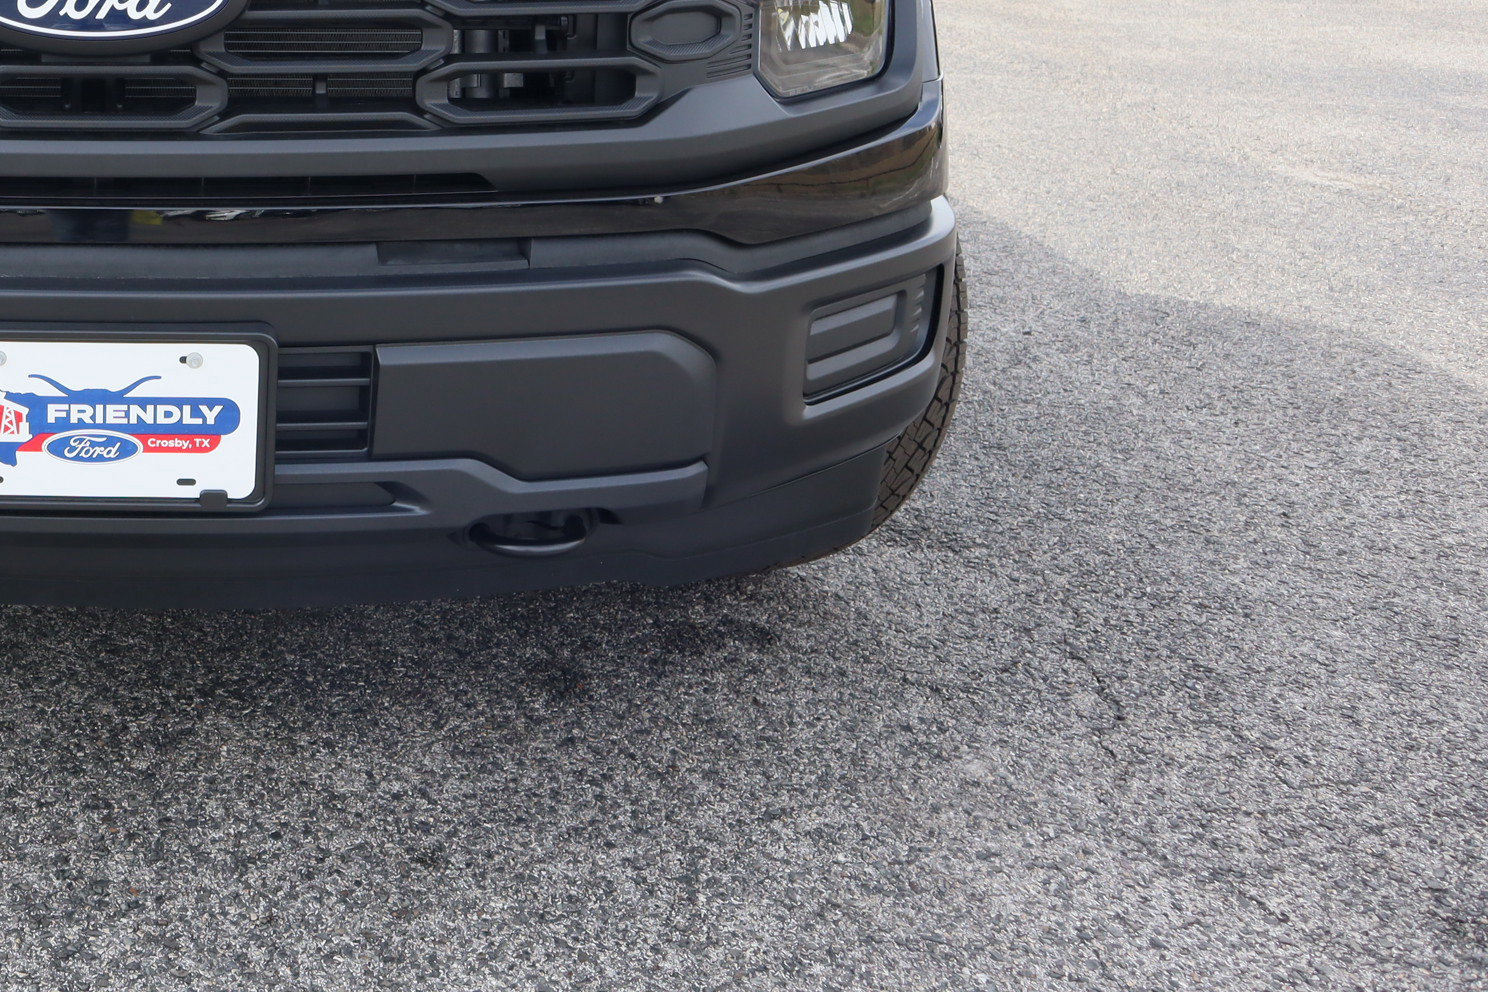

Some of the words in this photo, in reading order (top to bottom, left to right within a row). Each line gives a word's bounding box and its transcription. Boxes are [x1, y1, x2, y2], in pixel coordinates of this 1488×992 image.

[46, 403, 224, 426] FRIENDLY
[63, 435, 120, 459] Ford
[147, 437, 192, 451] Crosby,
[194, 438, 211, 449] TX
